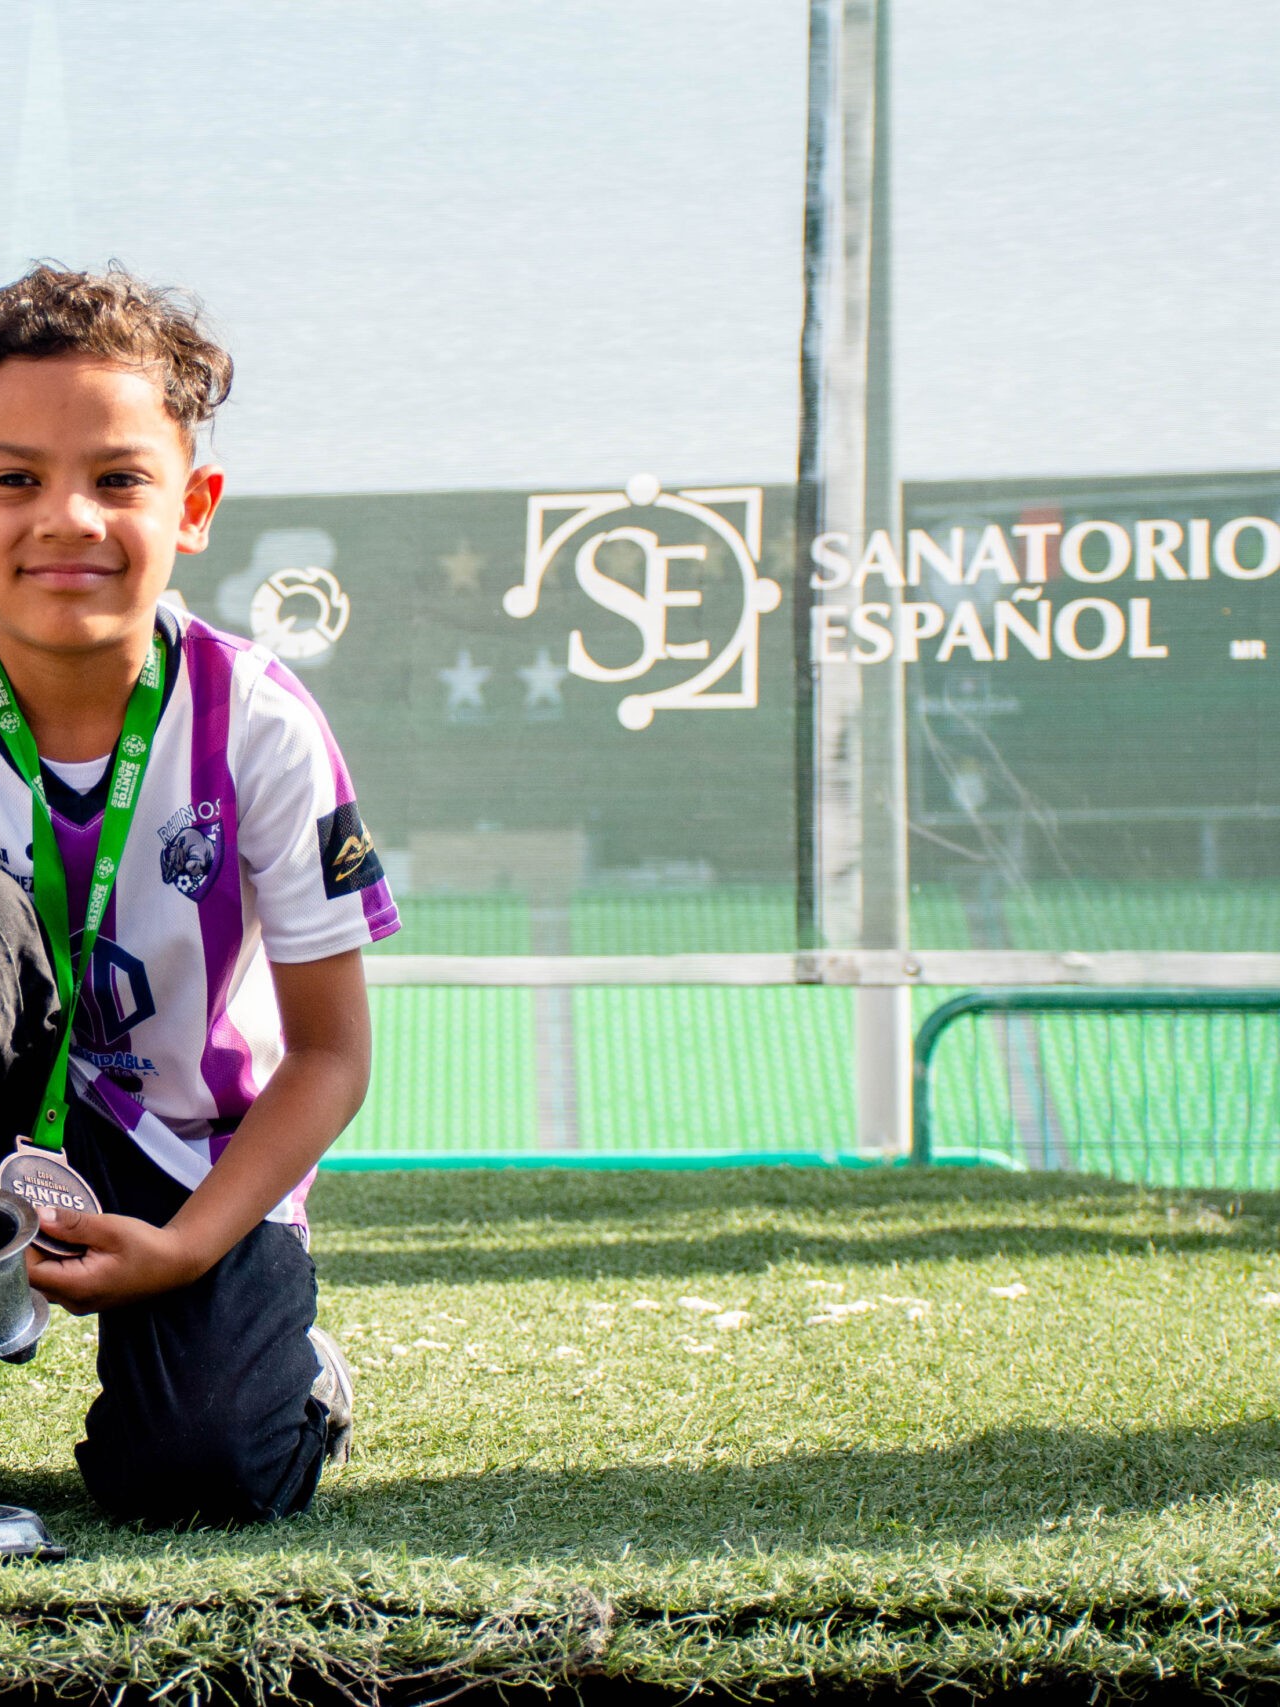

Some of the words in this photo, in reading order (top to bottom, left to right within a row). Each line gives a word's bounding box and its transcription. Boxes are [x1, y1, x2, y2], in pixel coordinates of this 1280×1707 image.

[809, 516, 1280, 590] SANATORIO
[809, 586, 1169, 664] ESPAÑOL
[116, 761, 136, 808] SANTOS
[13, 1180, 85, 1211] SANTOS
